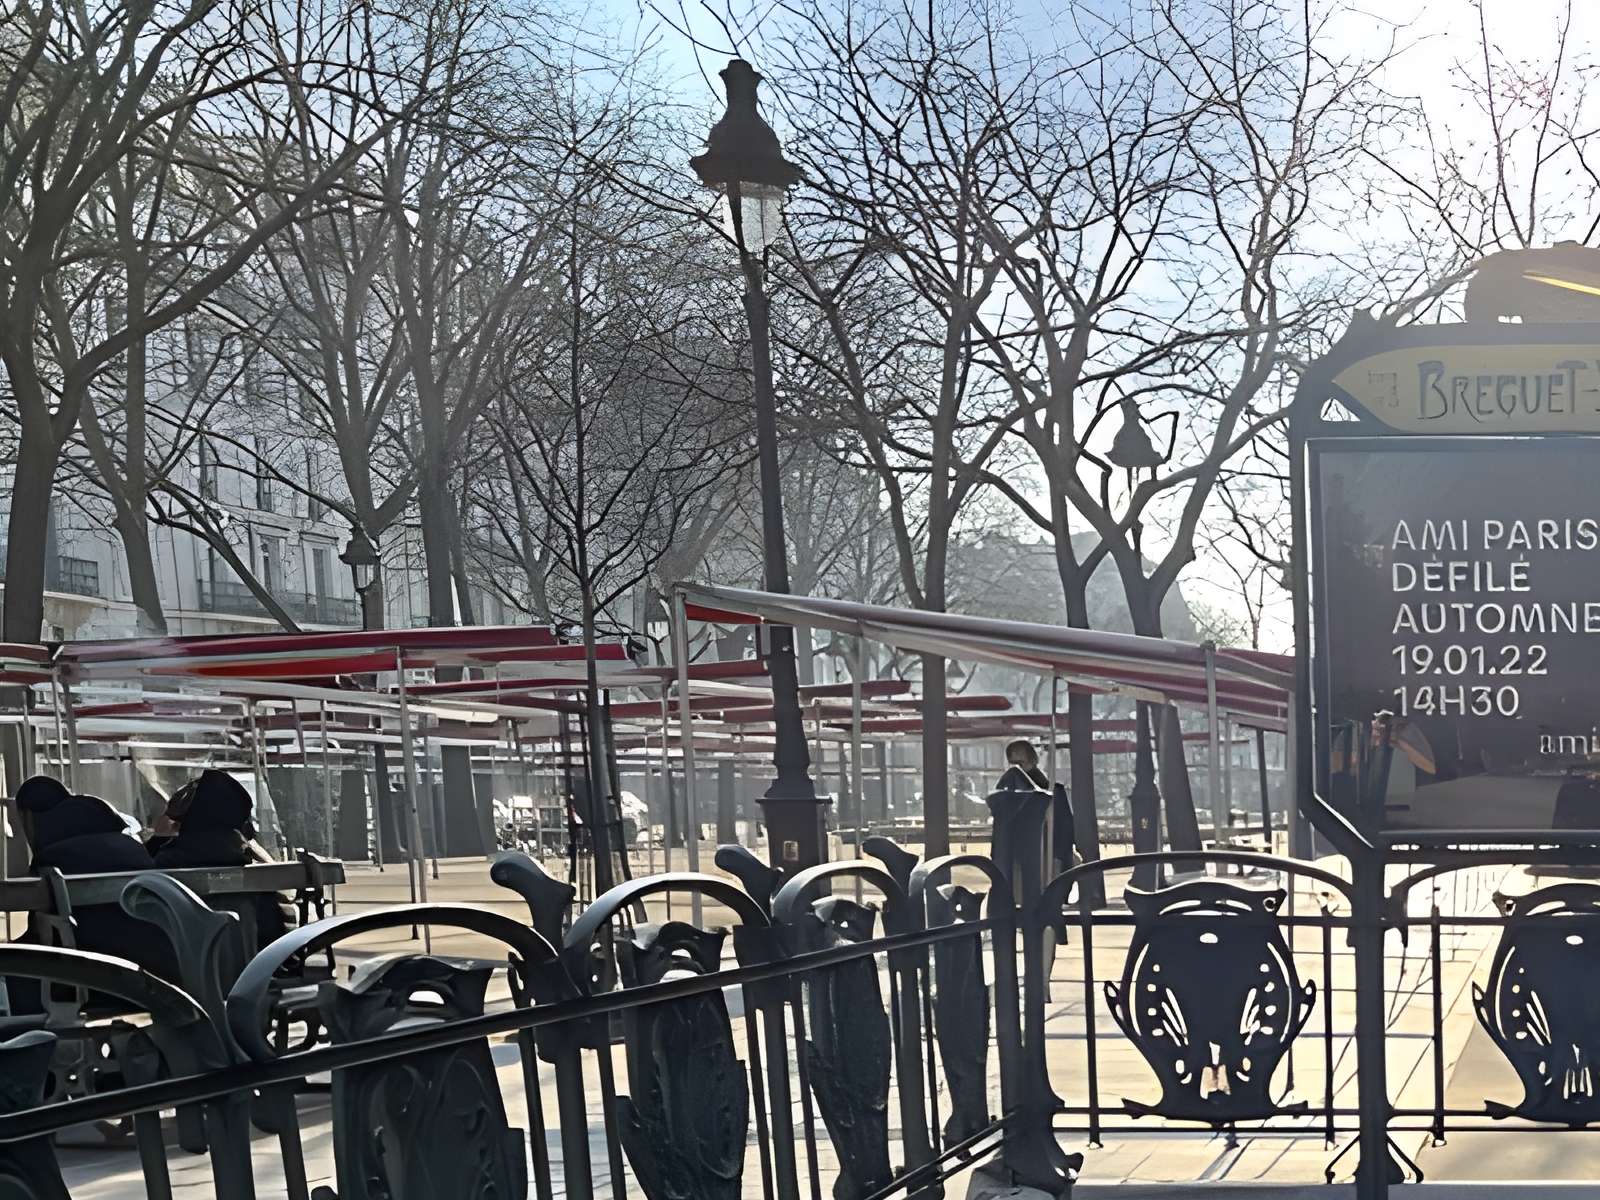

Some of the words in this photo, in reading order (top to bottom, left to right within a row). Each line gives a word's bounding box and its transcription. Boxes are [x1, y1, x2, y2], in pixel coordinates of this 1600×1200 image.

[1392, 519, 1468, 550] AMI
[1484, 519, 1598, 550] PARIS
[1392, 645, 1548, 675] 19.01.22
[1393, 685, 1519, 717] 14H30
